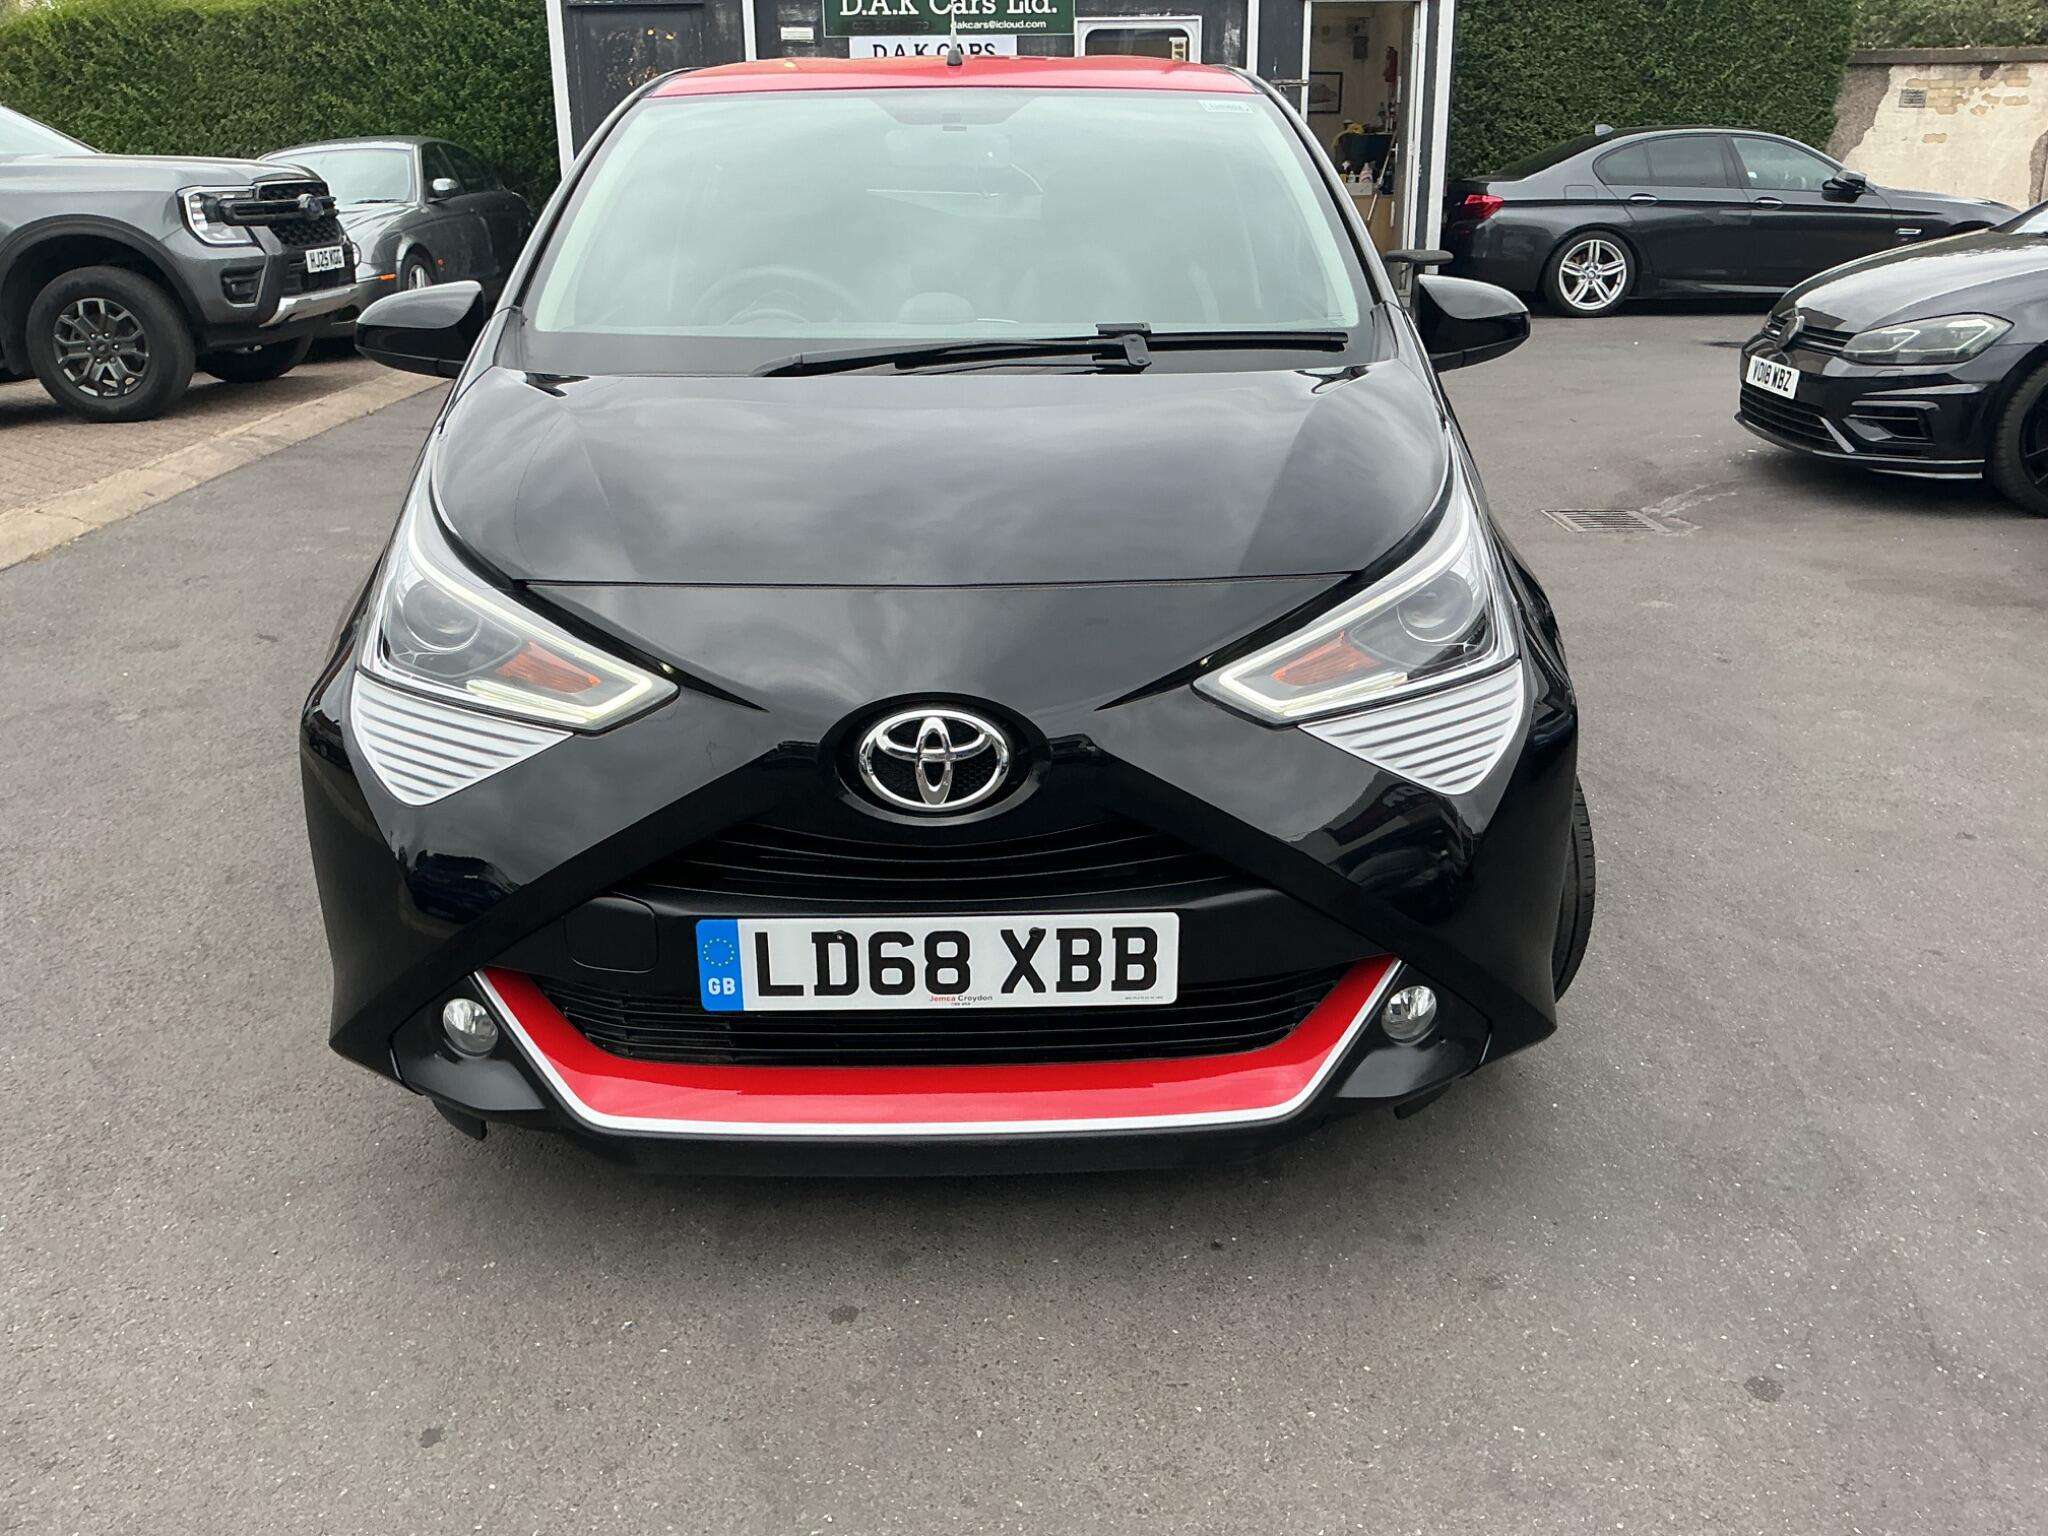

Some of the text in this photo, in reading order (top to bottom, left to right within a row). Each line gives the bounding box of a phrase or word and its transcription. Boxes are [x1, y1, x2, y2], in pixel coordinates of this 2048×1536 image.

[755, 927, 1158, 996] LD68 XBB
[708, 977, 736, 995] GB
